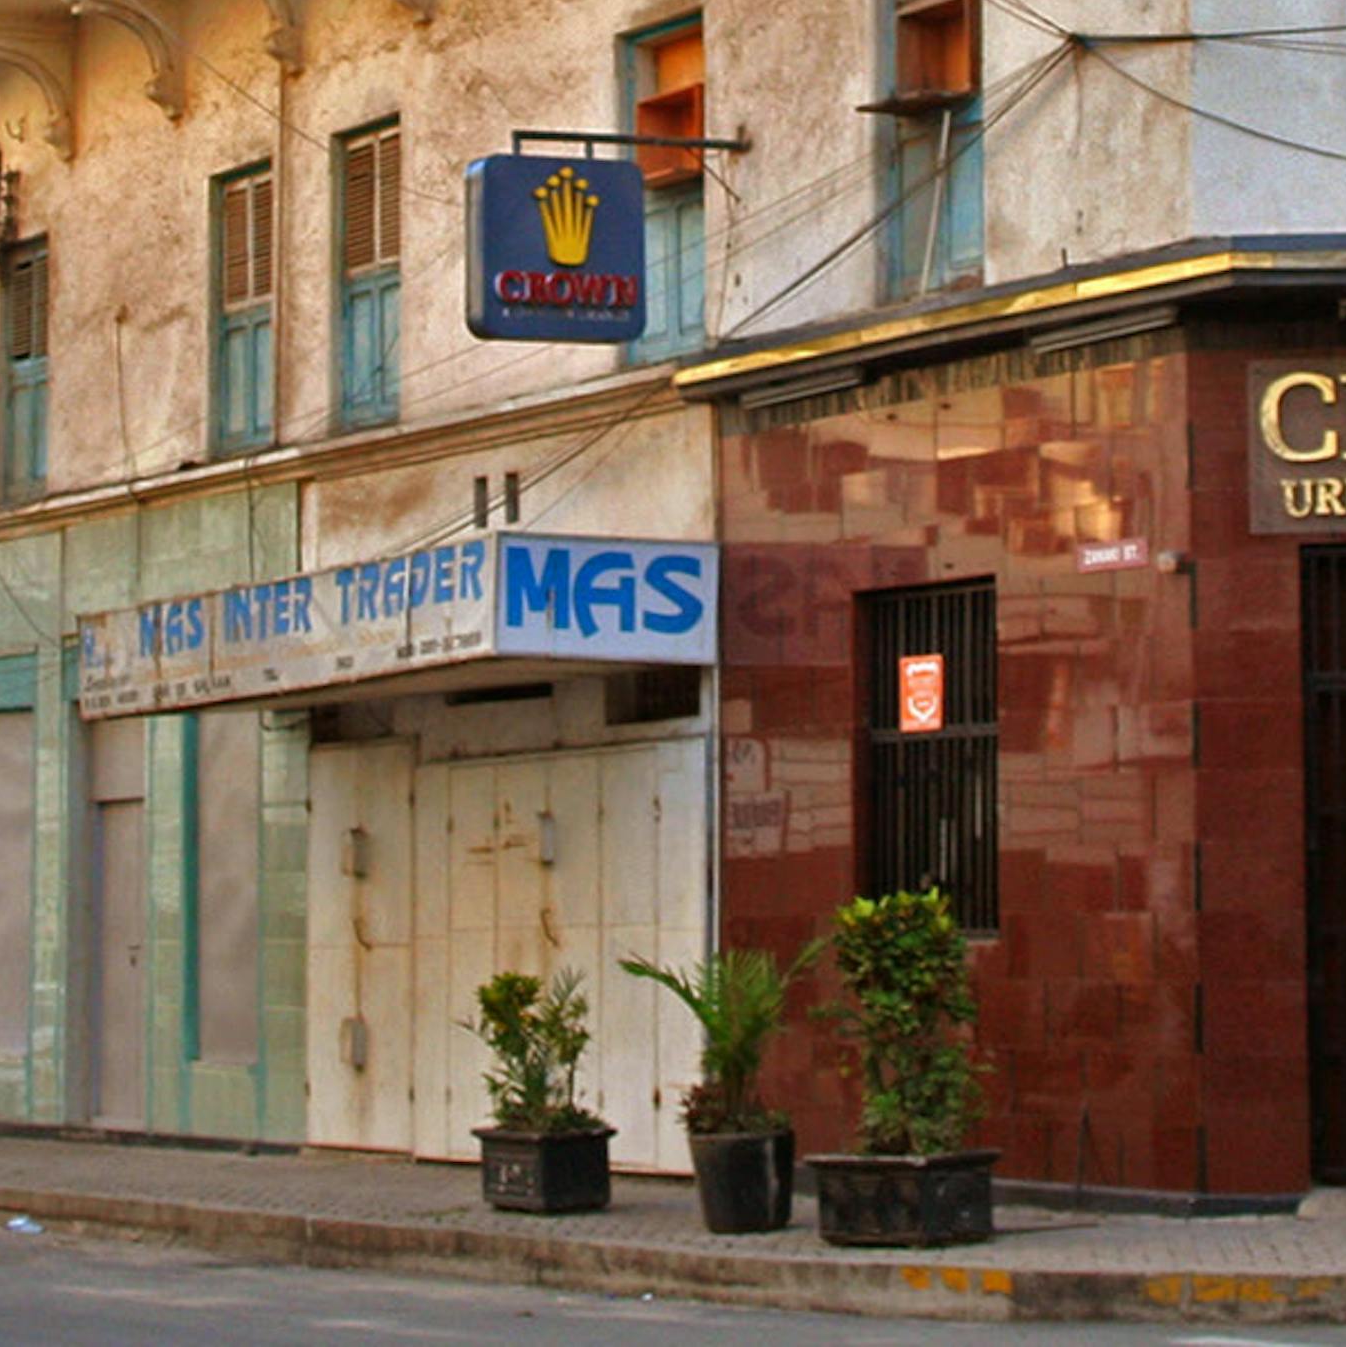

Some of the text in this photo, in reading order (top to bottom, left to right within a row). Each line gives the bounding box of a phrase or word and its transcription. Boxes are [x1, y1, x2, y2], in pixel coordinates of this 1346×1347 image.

[495, 270, 638, 306] CROWN
[223, 575, 313, 642] INTER
[335, 540, 486, 625] TRADER
[506, 546, 704, 638] MAS
